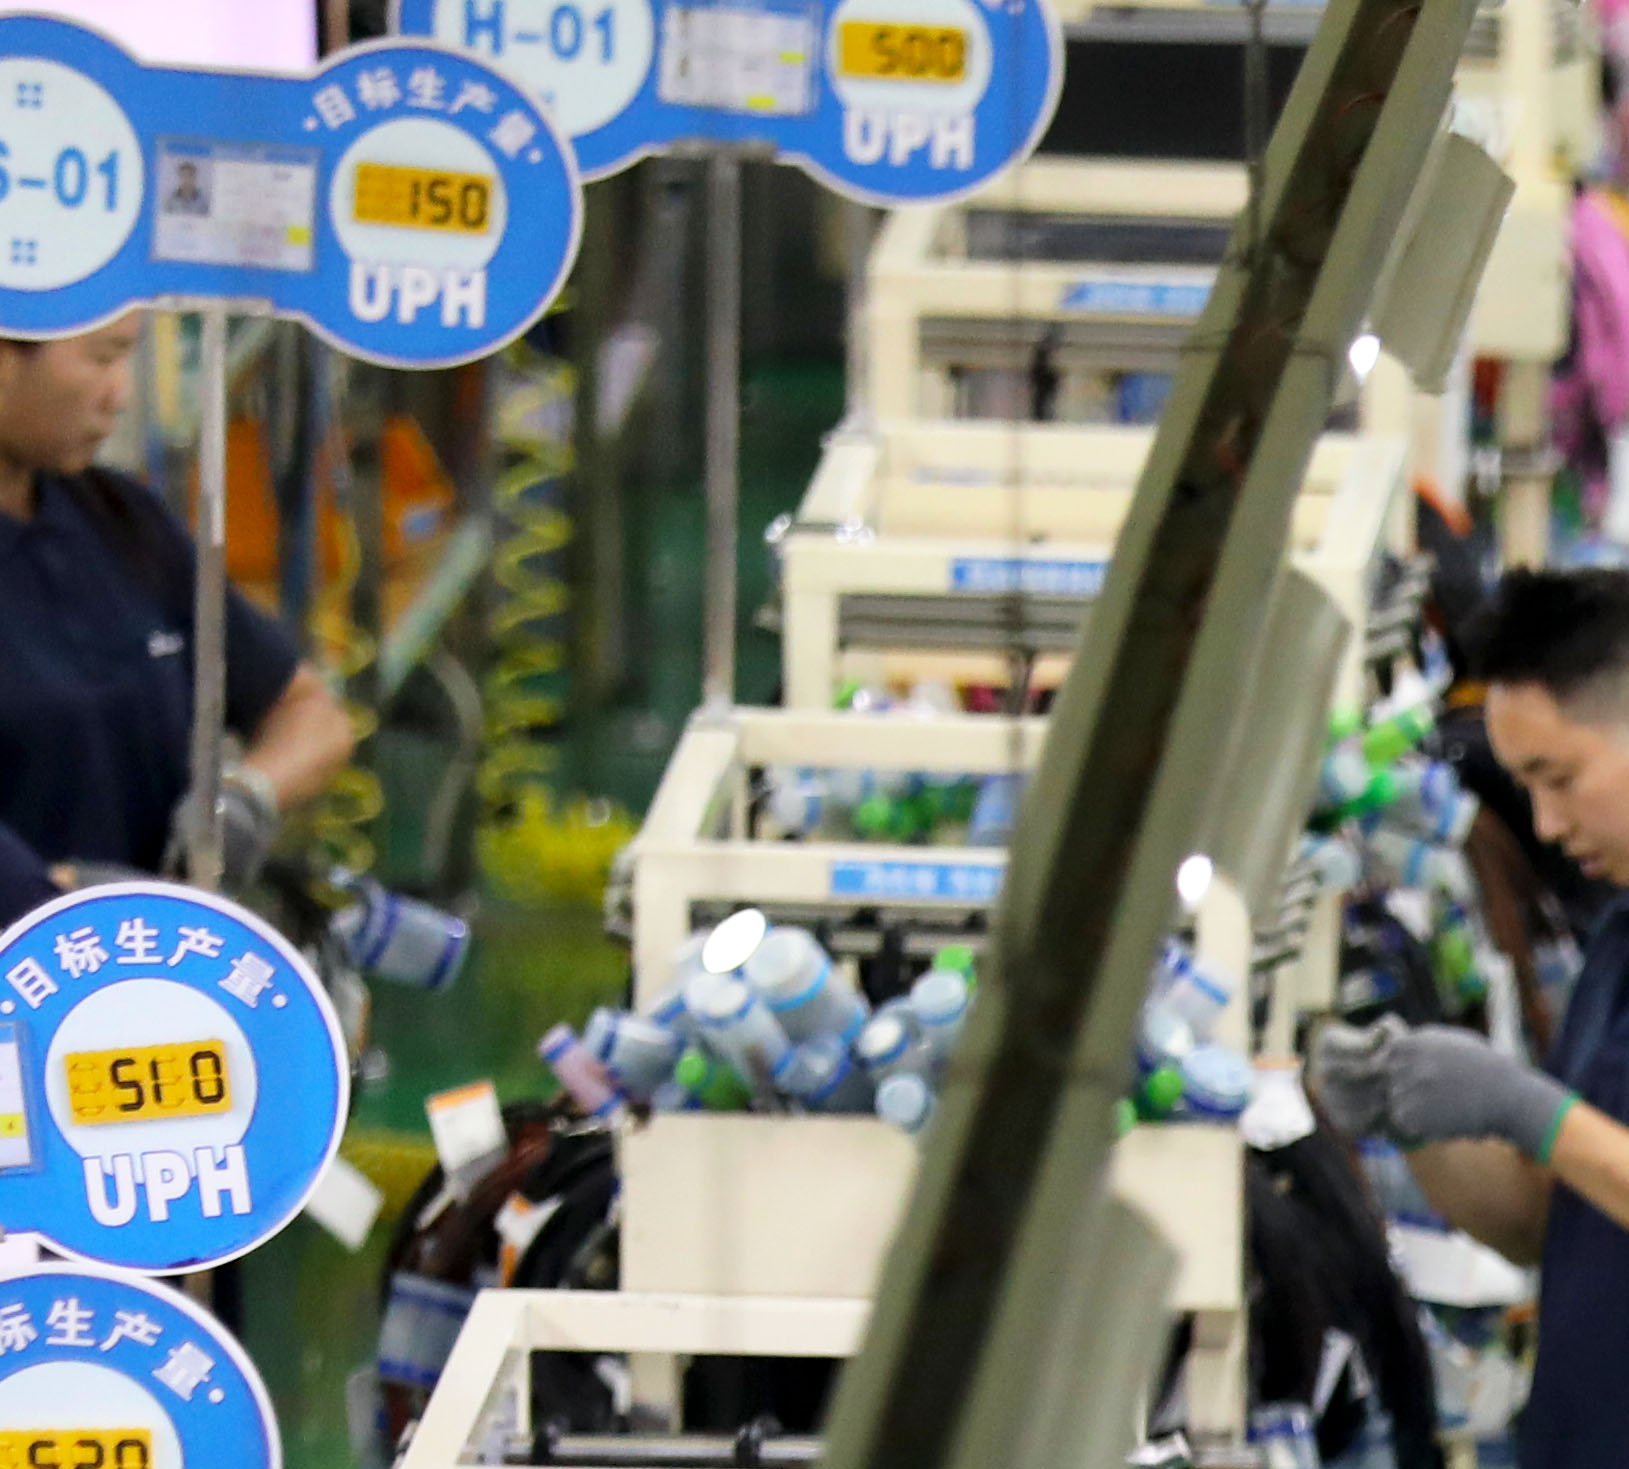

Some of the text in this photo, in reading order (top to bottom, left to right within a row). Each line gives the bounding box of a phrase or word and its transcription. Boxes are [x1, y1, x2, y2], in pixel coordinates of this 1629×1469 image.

[464, 0, 619, 60] H-01
[870, 30, 967, 77] 500
[316, 69, 540, 164] 目标生产量
[842, 108, 975, 170] UPH
[0, 144, 120, 213] -01
[407, 174, 490, 230] 150
[348, 259, 488, 329] UPH
[4, 915, 278, 1012] 目标生产量
[108, 1048, 227, 1113] 510
[83, 1144, 252, 1229] UPH
